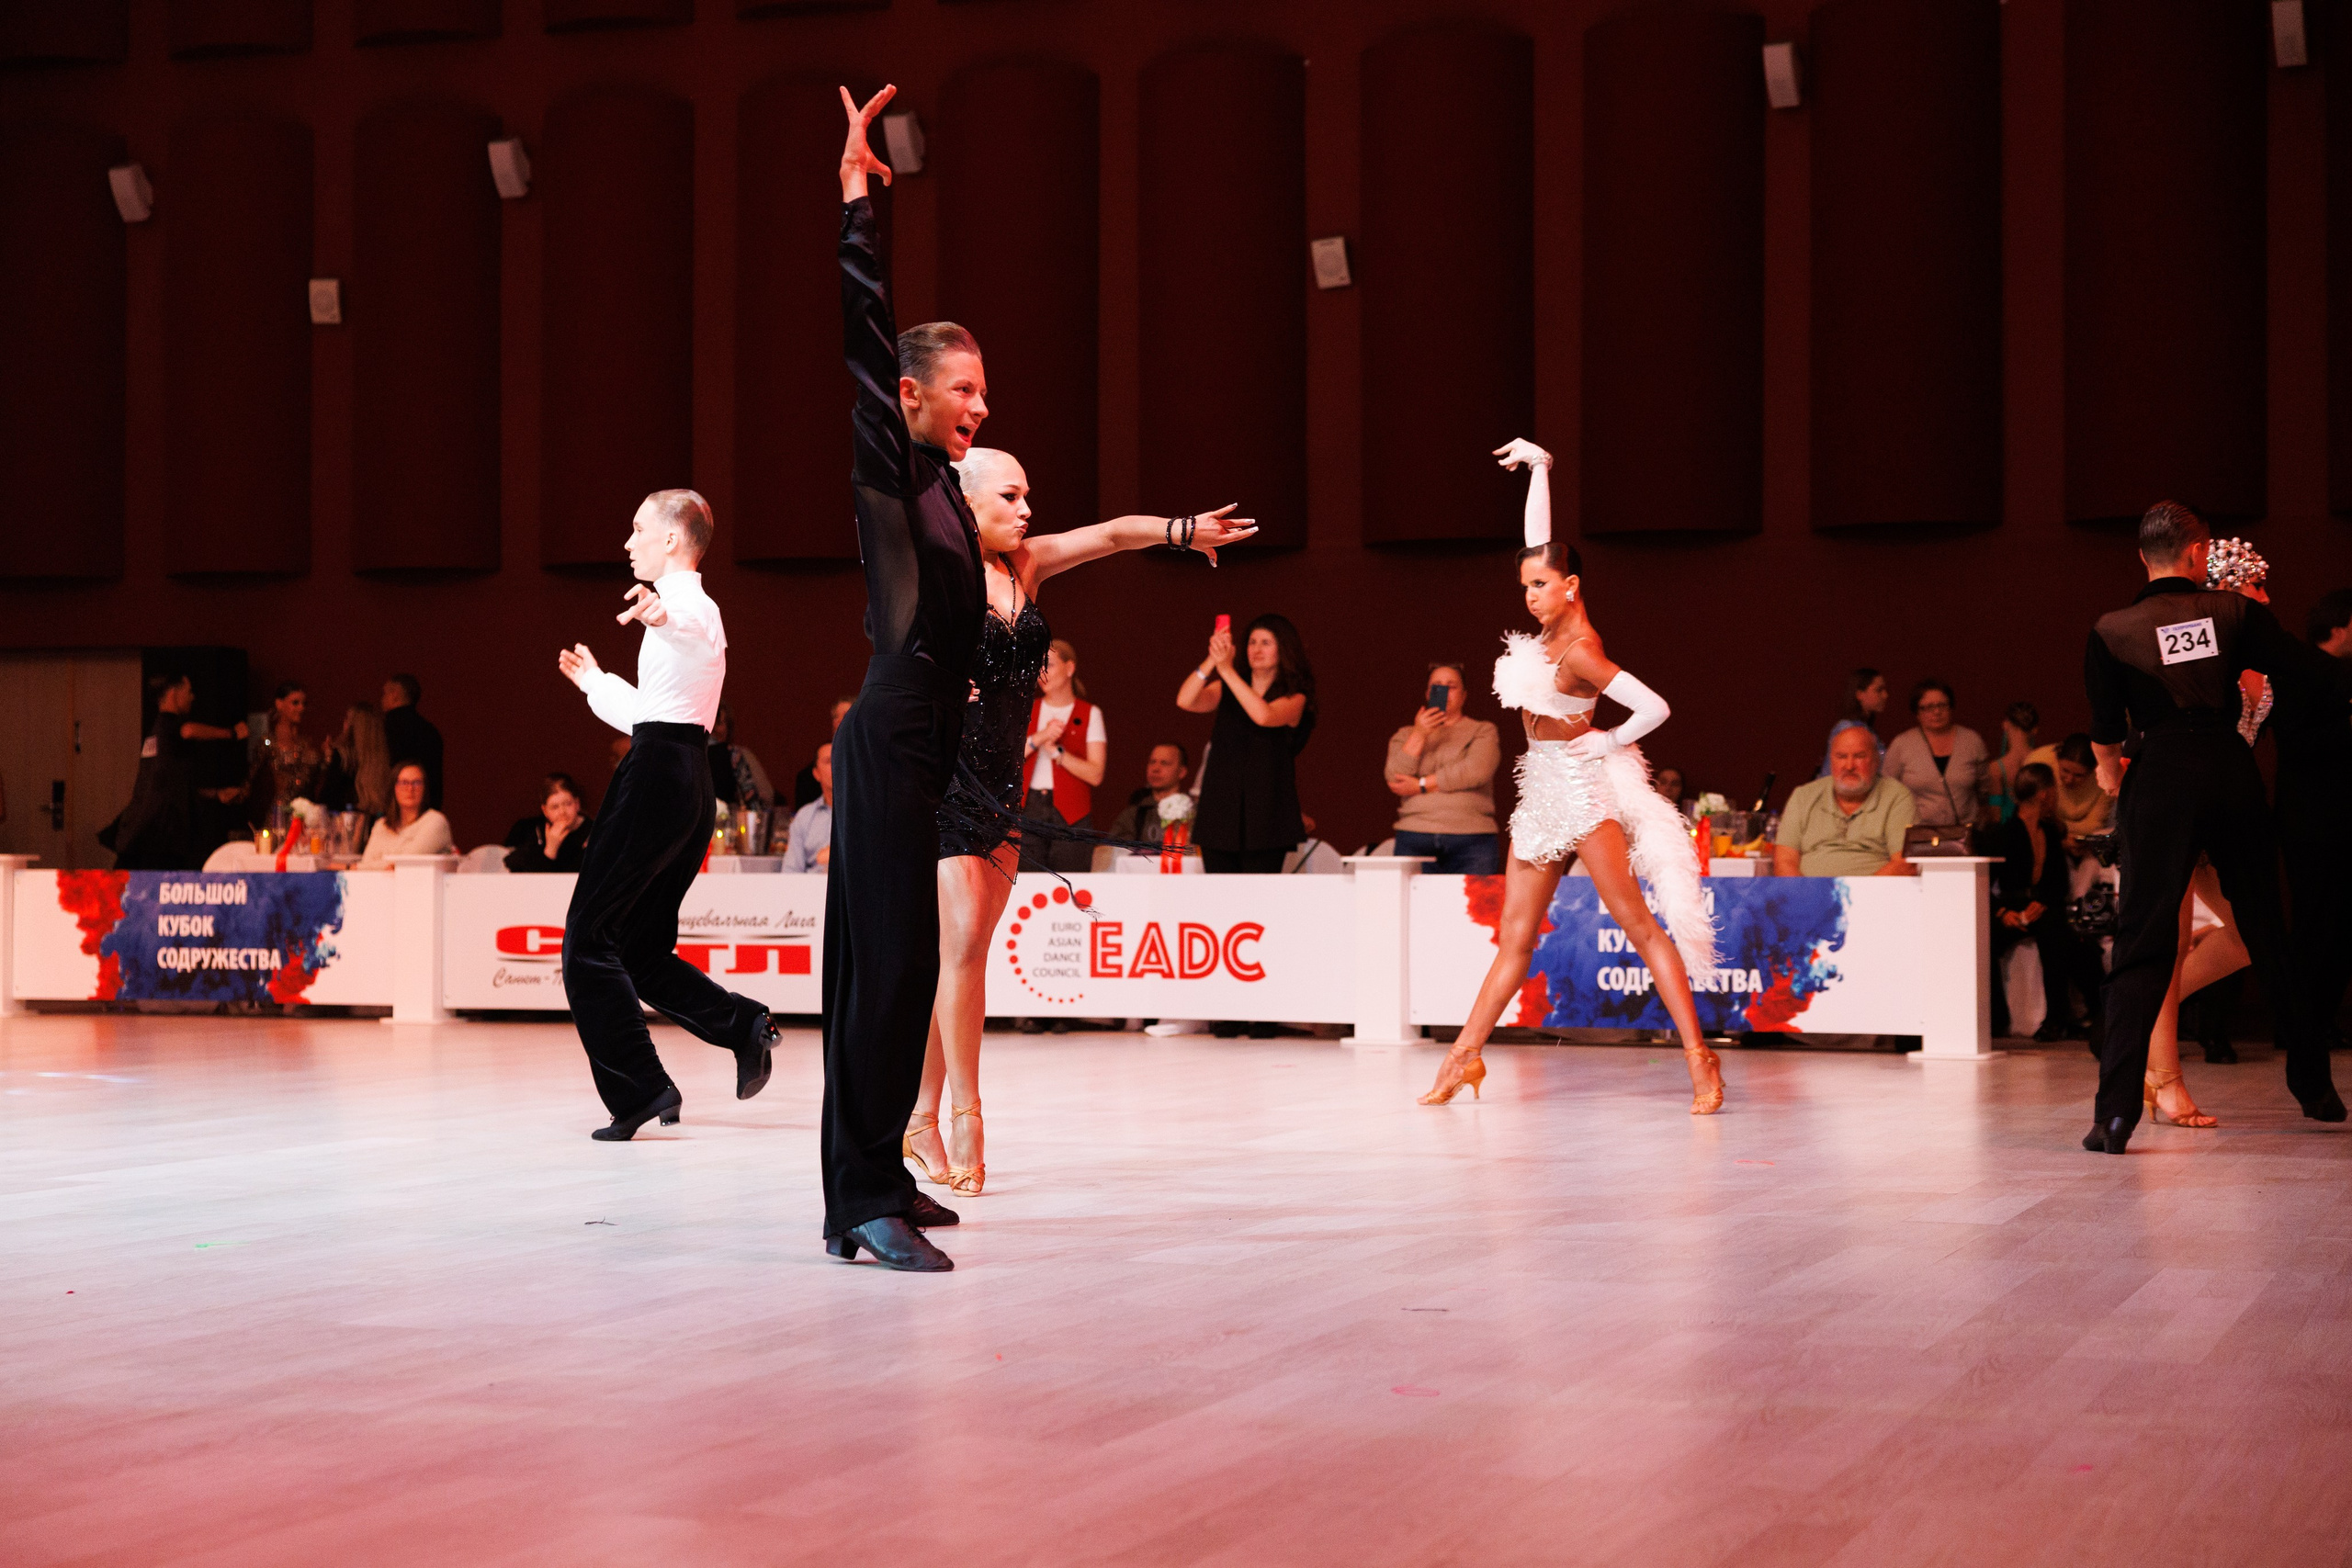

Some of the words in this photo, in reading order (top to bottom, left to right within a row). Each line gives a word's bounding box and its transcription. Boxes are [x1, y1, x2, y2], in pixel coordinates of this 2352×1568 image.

[2165, 627, 2211, 655] 234
[159, 879, 248, 906] БОЛЬШОЙ
[158, 914, 215, 937] КУБОК
[1051, 922, 1082, 932] EURO
[1047, 938, 1081, 947] ASIAN
[1090, 921, 1266, 982] EADC
[156, 946, 282, 974] СОДРУЖЕСТВА
[1043, 953, 1080, 963] DANCE
[1032, 967, 1080, 978] COUNCIL
